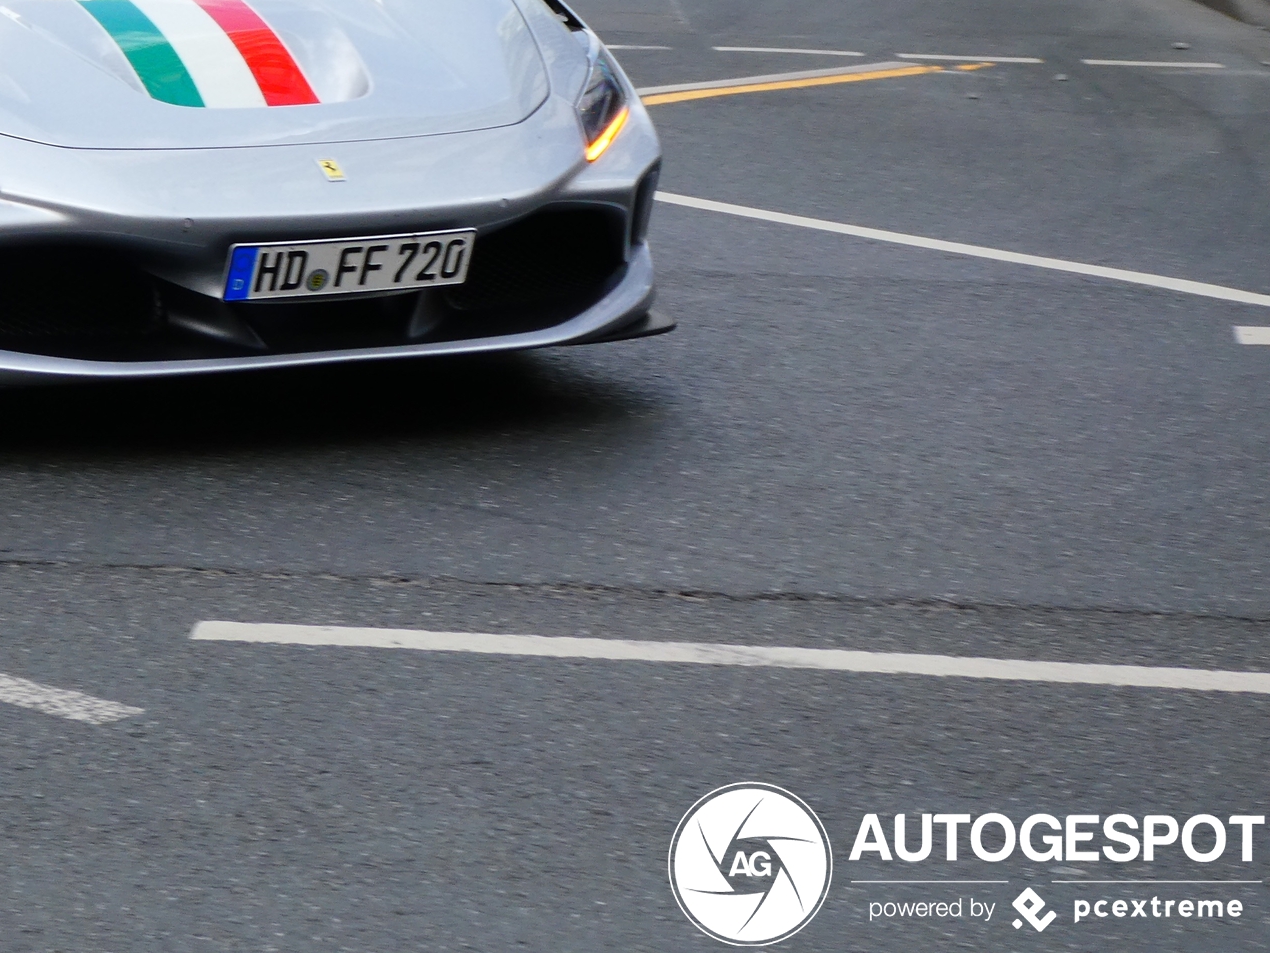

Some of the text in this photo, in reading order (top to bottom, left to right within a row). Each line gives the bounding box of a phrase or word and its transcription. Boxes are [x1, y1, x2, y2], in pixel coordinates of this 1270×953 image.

[253, 239, 467, 292] HD FF 720
